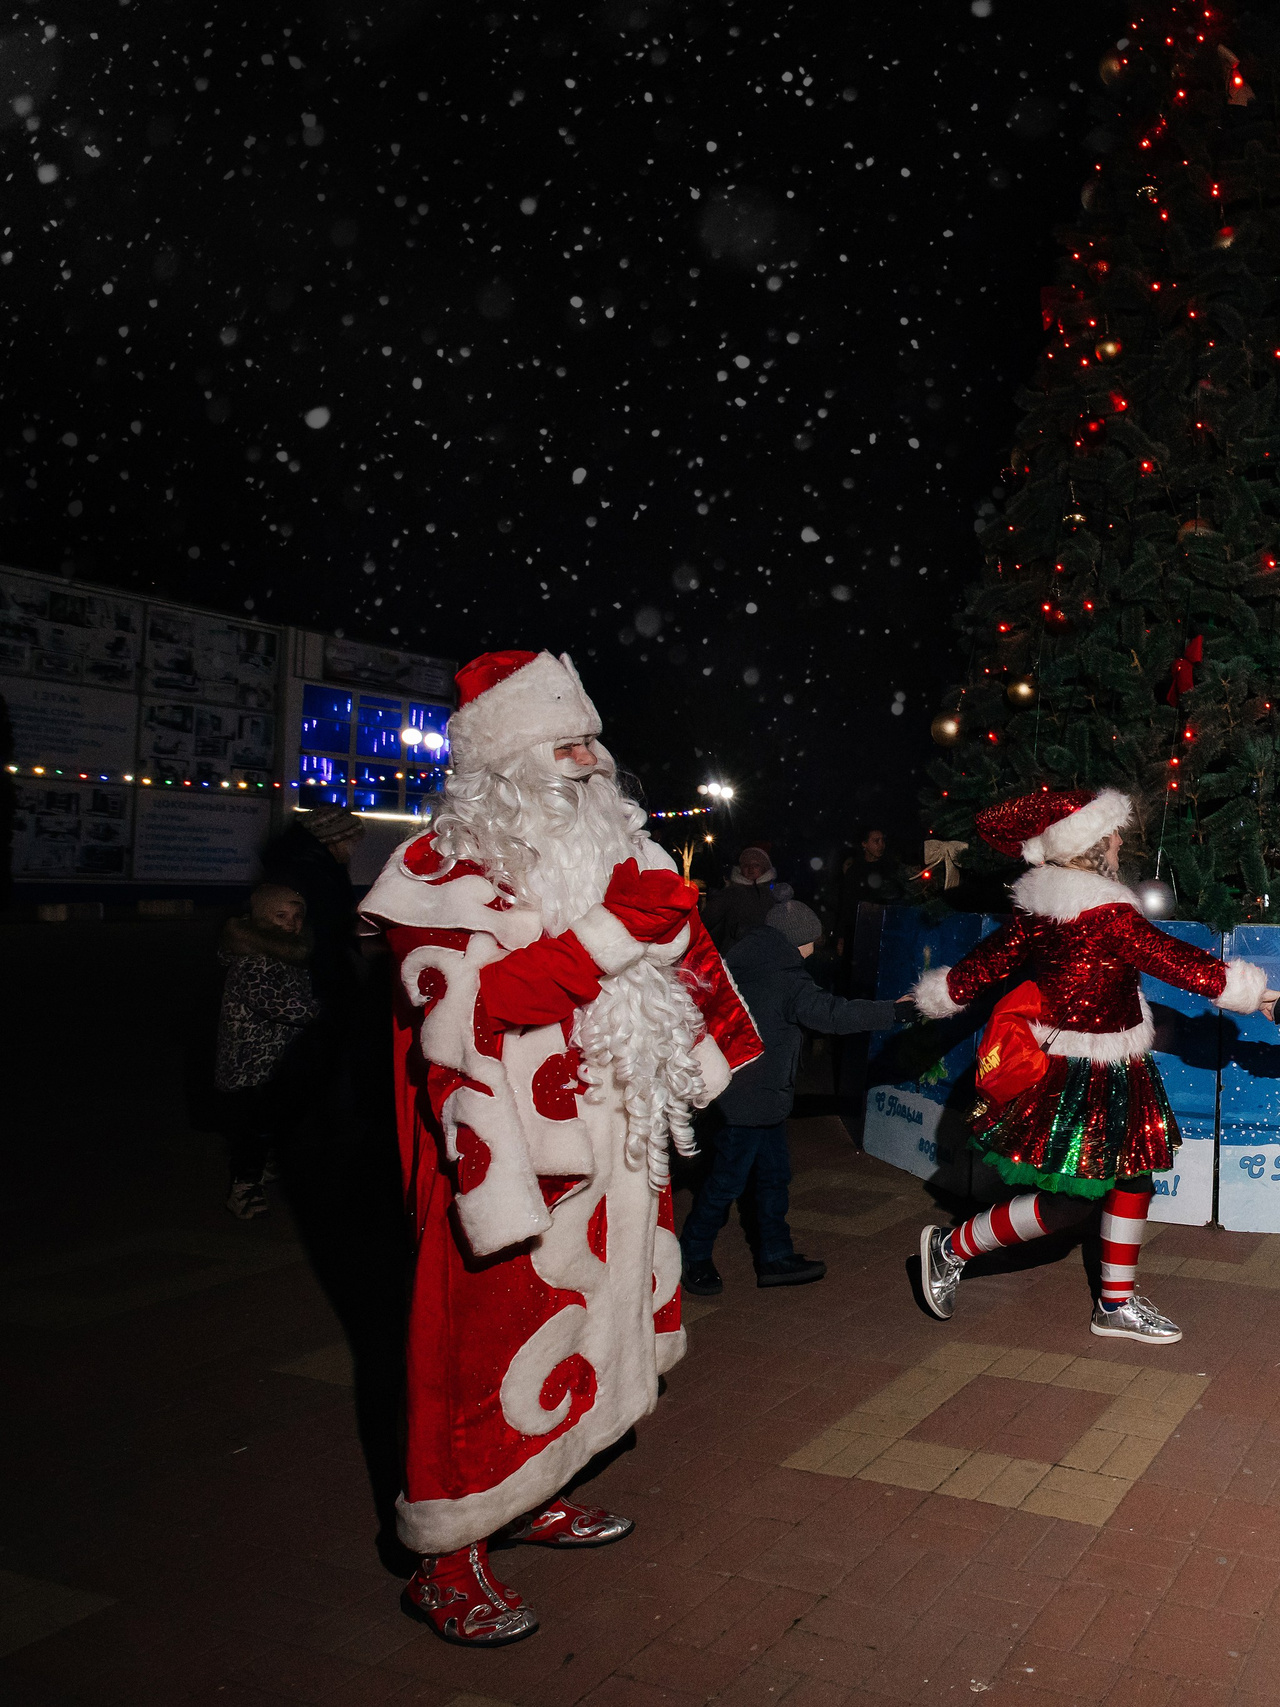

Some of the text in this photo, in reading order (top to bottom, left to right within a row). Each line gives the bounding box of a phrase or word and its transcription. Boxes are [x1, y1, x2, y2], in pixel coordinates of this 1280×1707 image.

[875, 1091, 923, 1125] С Новым
[1239, 1153, 1266, 1179] С
